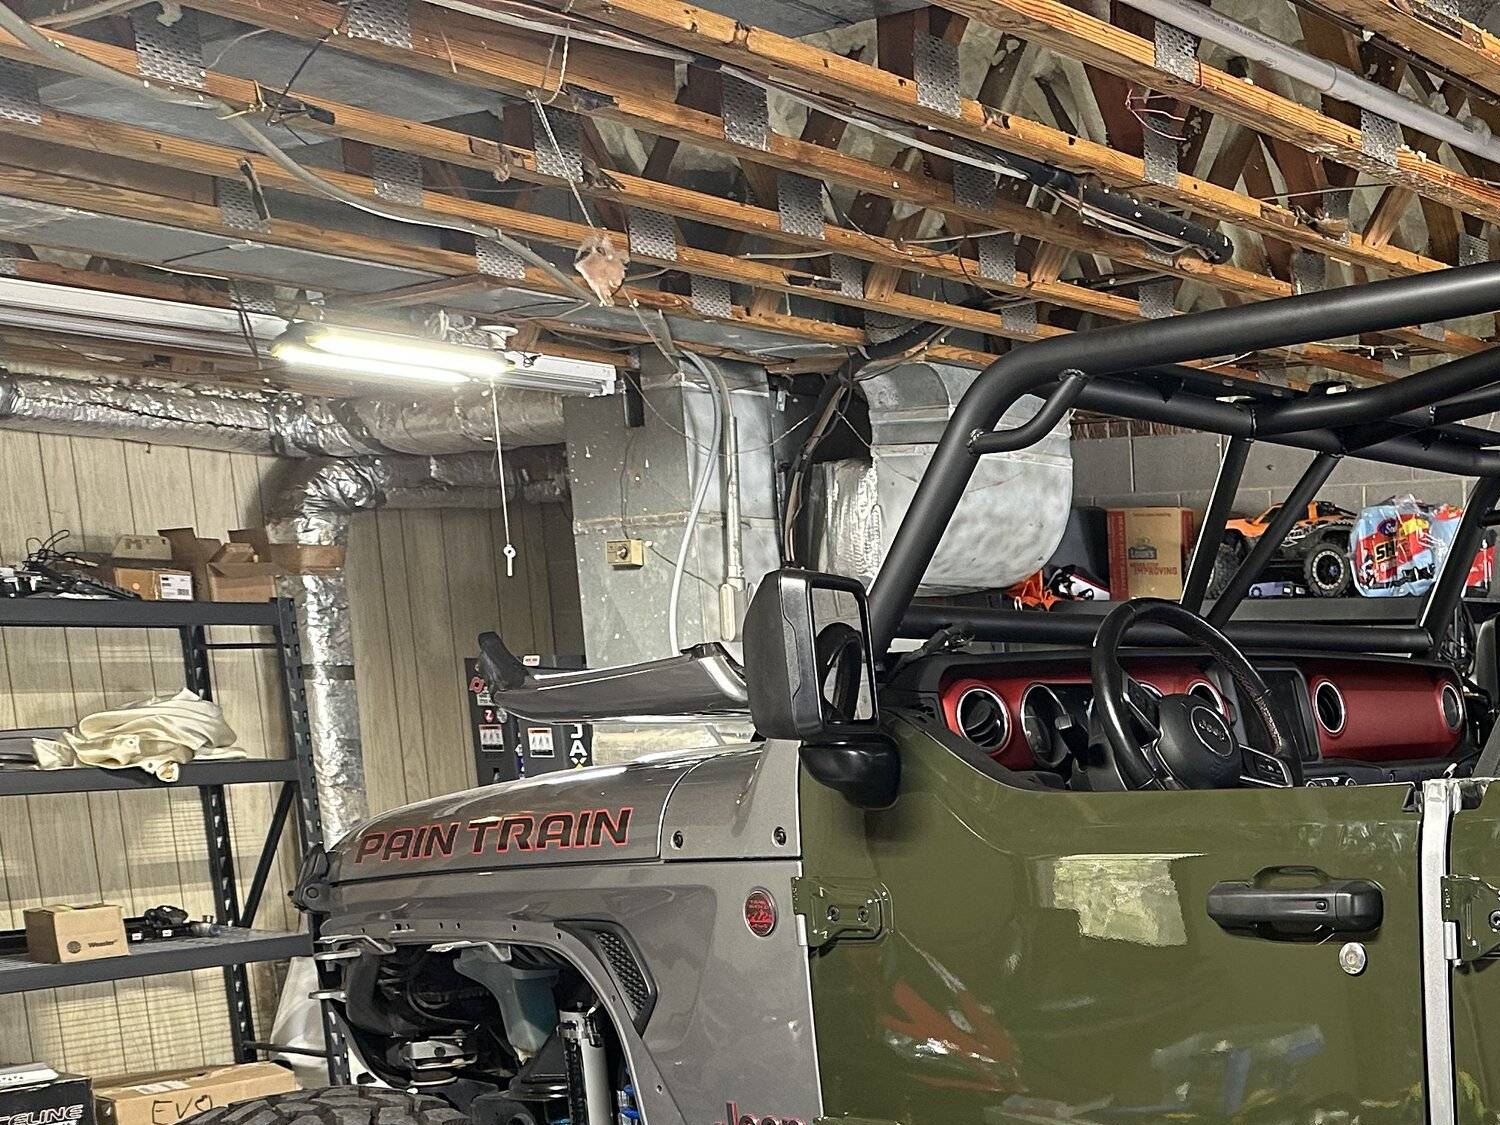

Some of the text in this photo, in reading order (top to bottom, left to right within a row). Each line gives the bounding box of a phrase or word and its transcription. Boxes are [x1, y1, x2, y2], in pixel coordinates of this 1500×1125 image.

[355, 807, 634, 864] PAIN TRAIN
[152, 1094, 213, 1125] EVO
